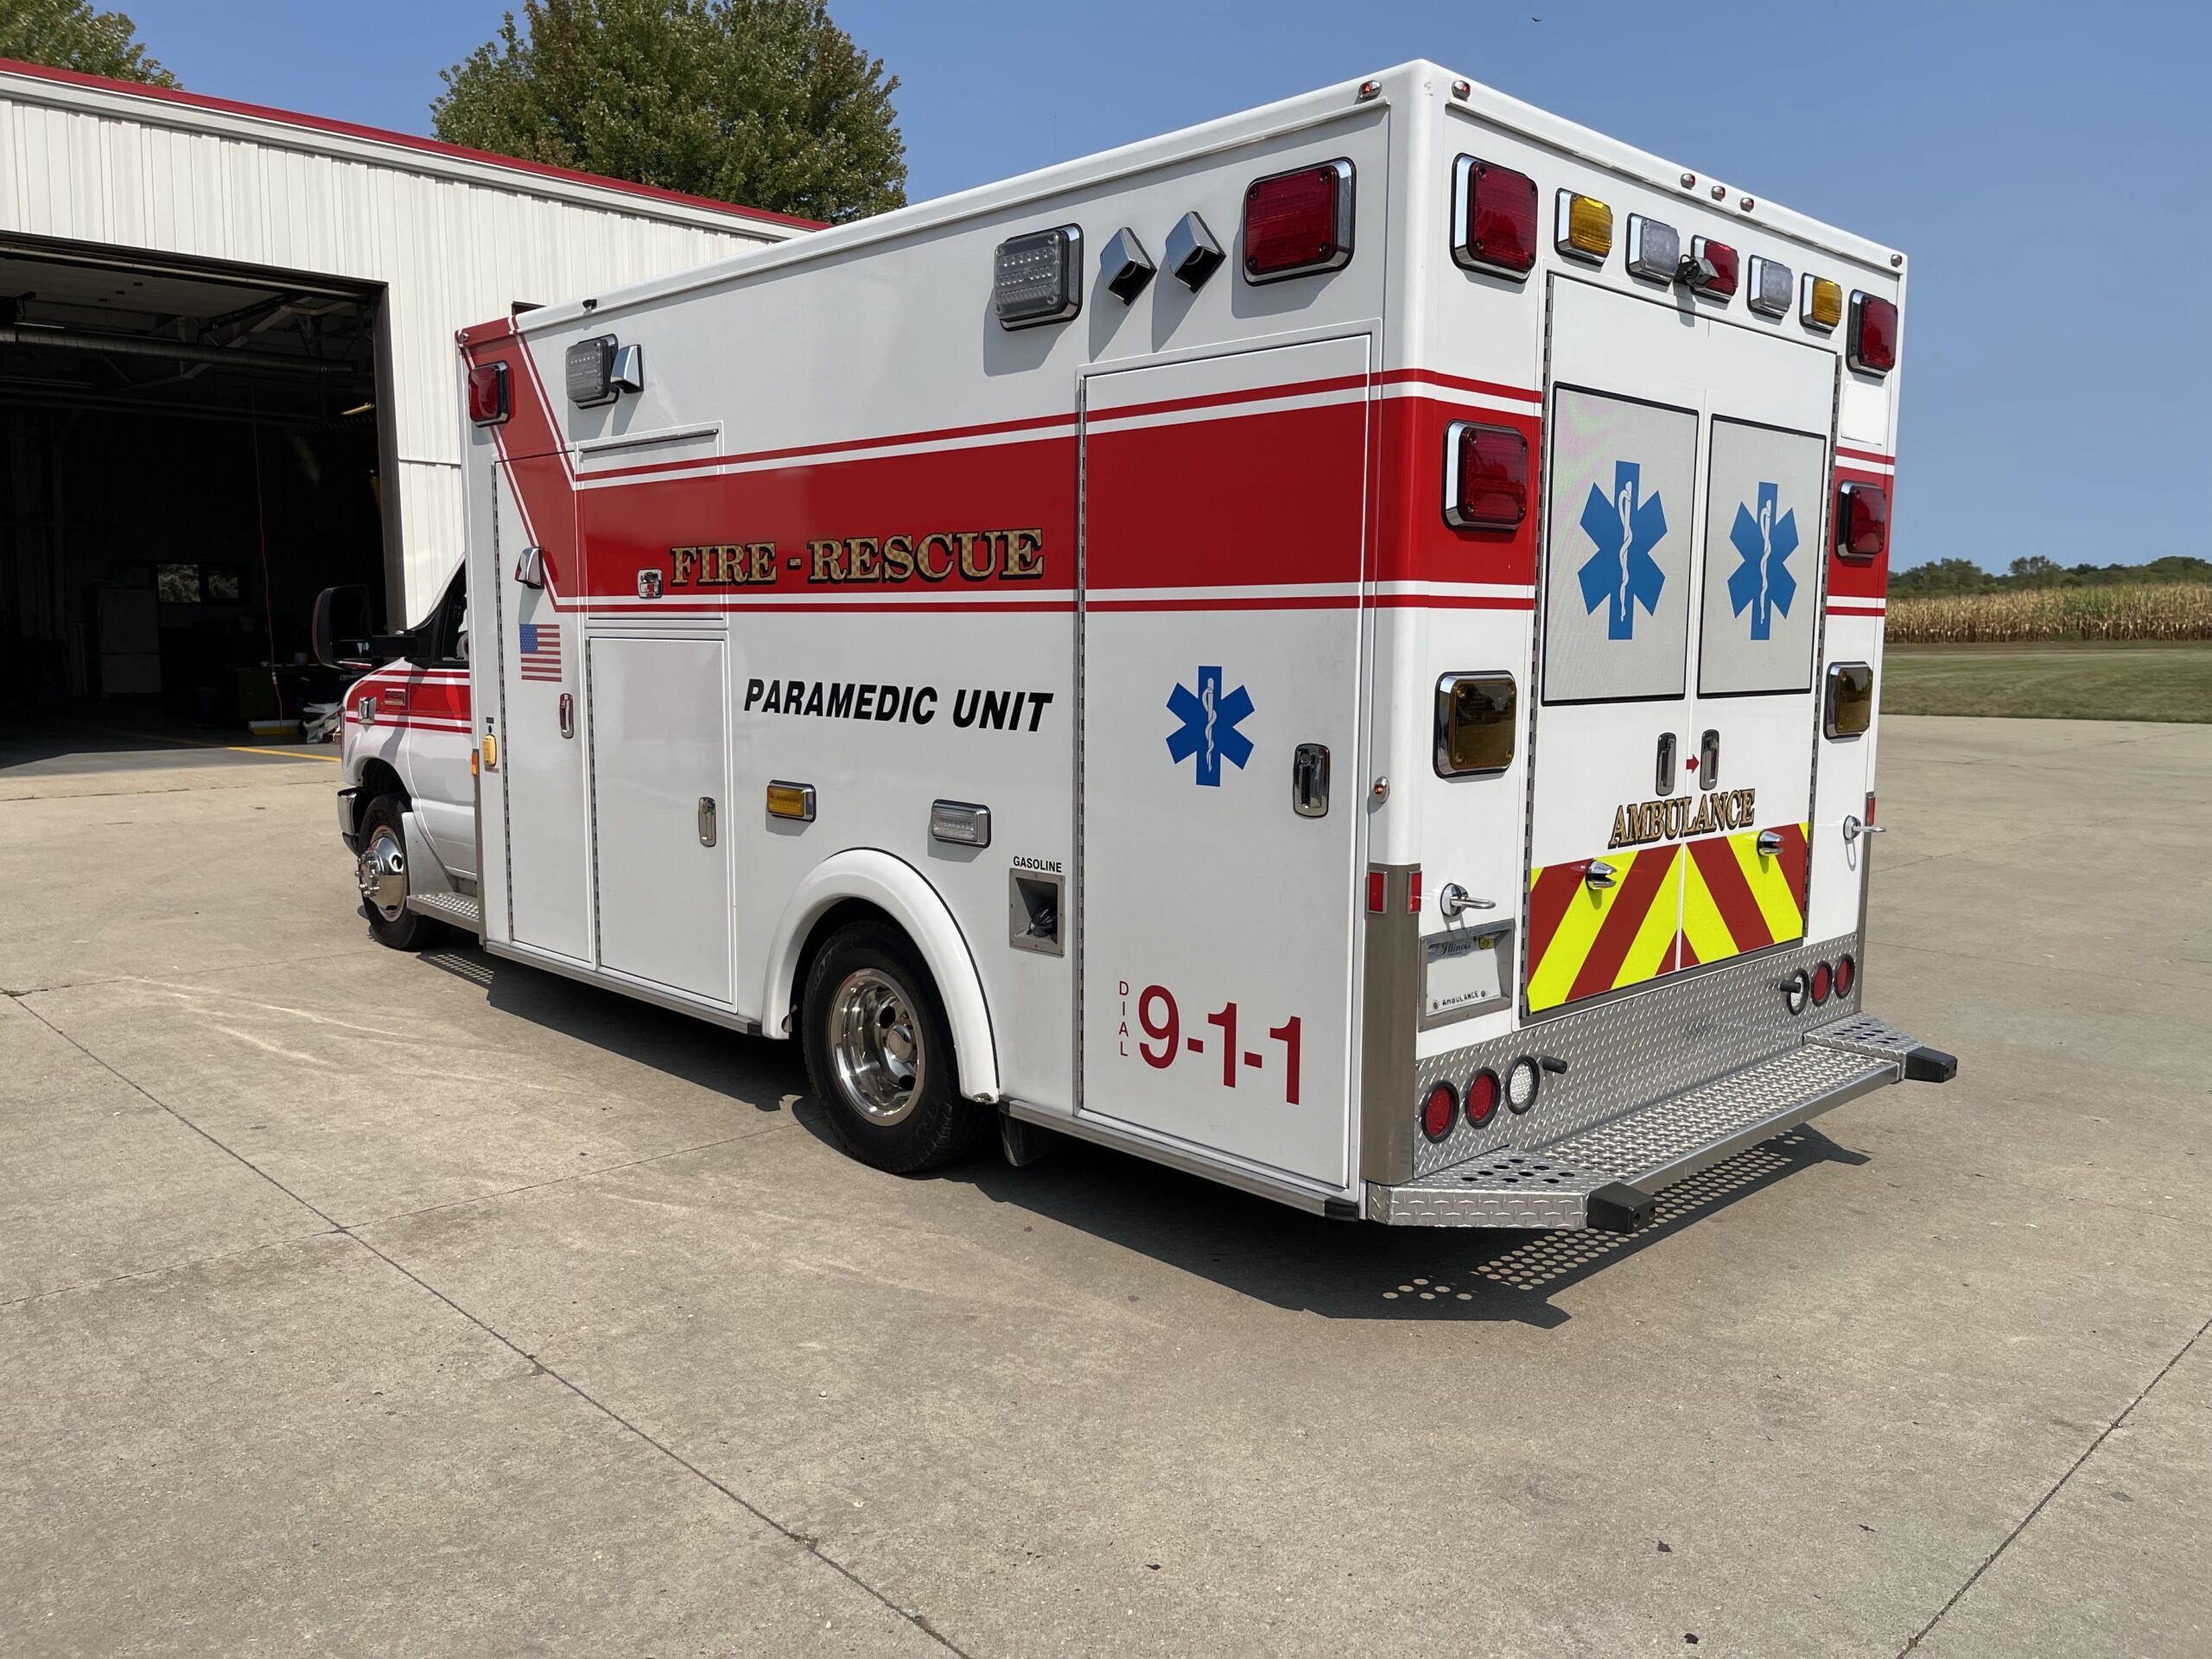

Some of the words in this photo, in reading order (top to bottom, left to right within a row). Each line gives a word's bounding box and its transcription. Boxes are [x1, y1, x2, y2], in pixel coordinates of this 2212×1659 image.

[670, 542, 776, 587] FIRE
[807, 527, 1045, 583] RESCUE
[744, 677, 938, 726] PARAMEDIC
[951, 688, 1054, 733] UNIT
[1607, 788, 1756, 850] AMBULANCE
[1013, 855, 1063, 874] GASOLINE
[1440, 940, 1471, 956] Illinois
[1118, 980, 1130, 1058] DIAL
[1442, 990, 1479, 1006] AMBULANCE
[1138, 983, 1302, 1106] 9-1-1
